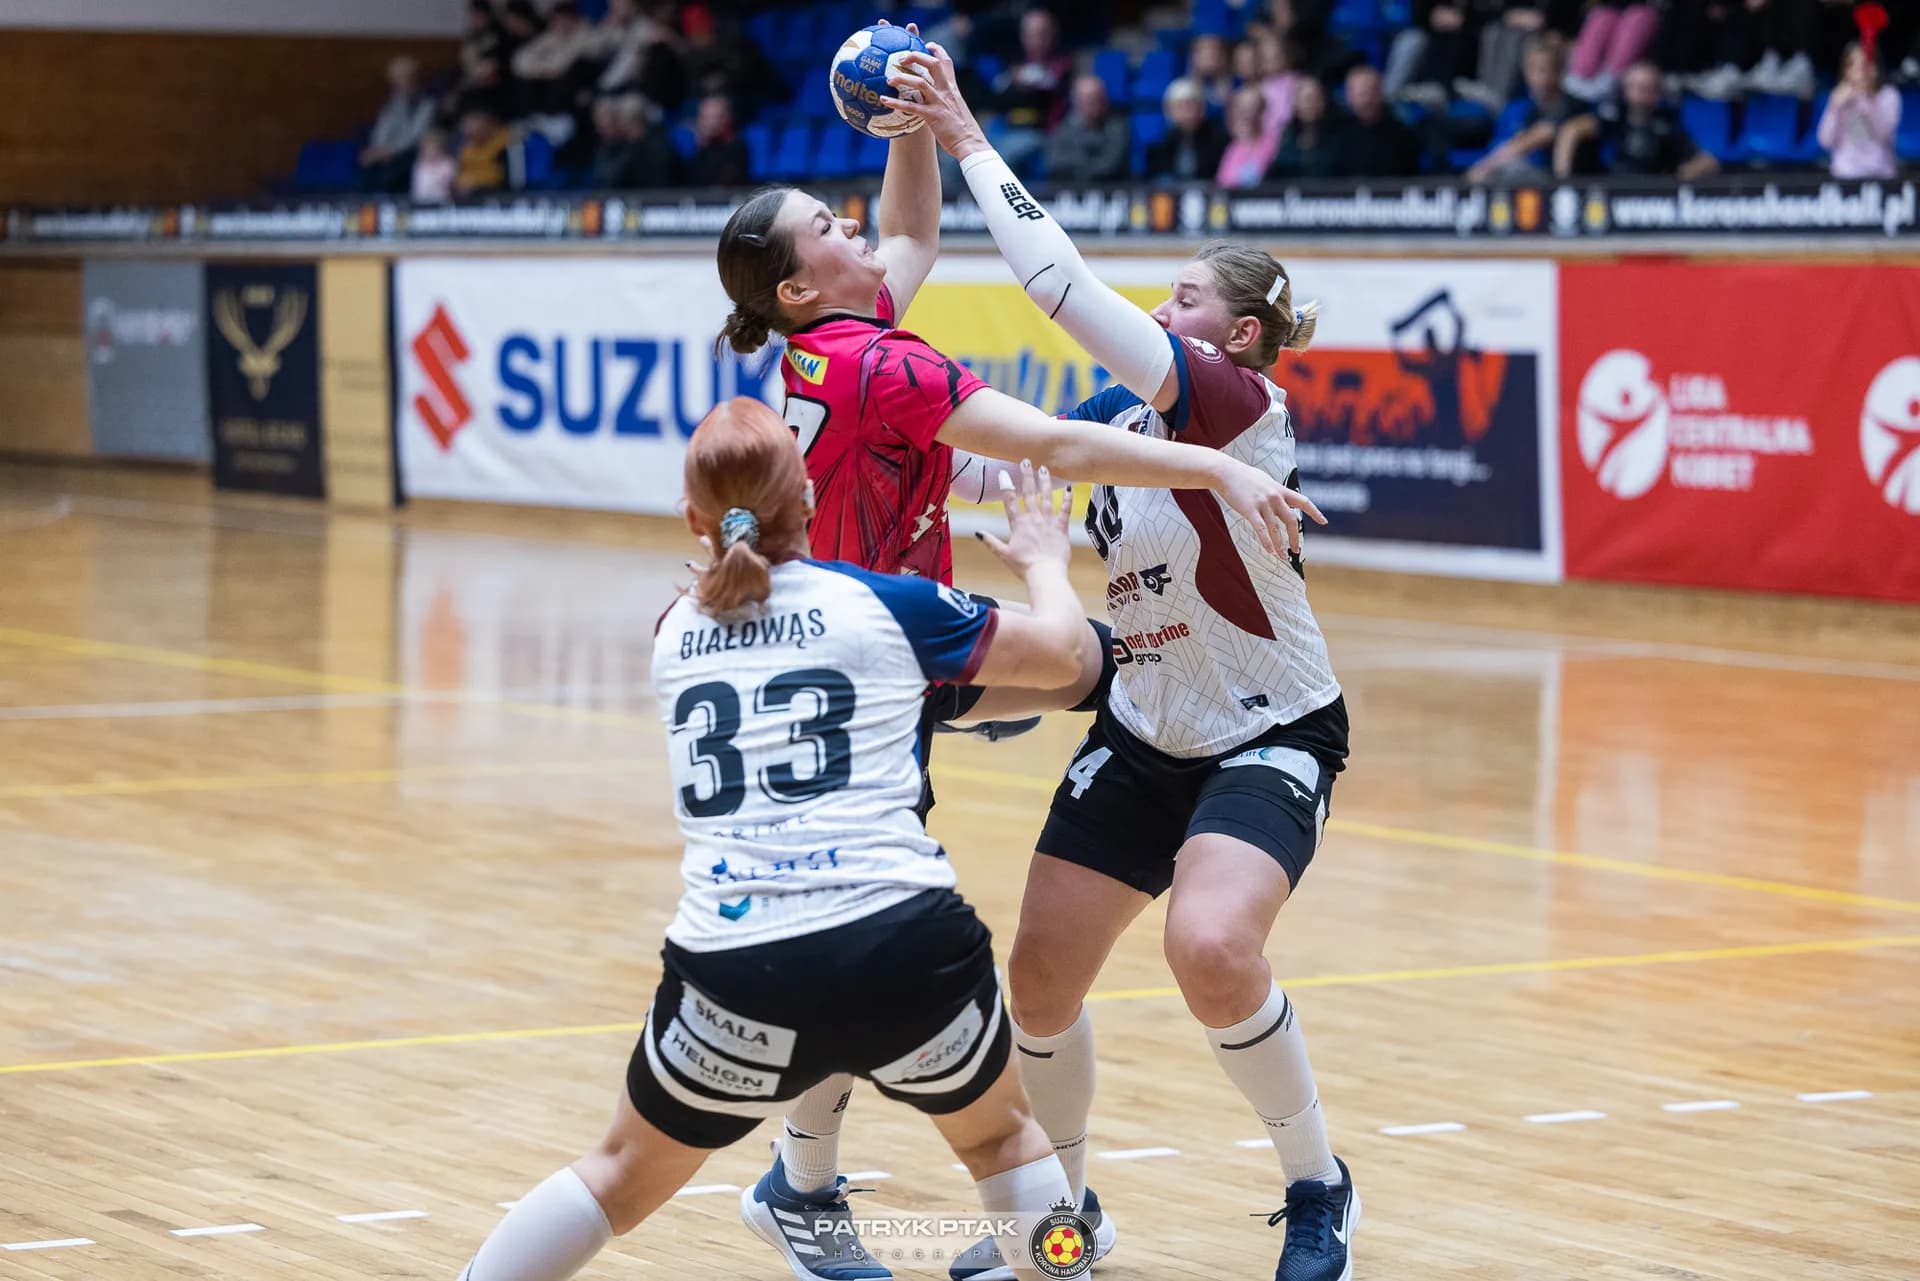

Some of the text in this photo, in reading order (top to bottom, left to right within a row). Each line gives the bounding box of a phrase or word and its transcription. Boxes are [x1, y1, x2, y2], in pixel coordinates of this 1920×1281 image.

[680, 608, 826, 660] BIAŁOWĄS
[672, 668, 855, 818] 33
[695, 999, 770, 1047] SKALA
[672, 1033, 763, 1088] HELION
